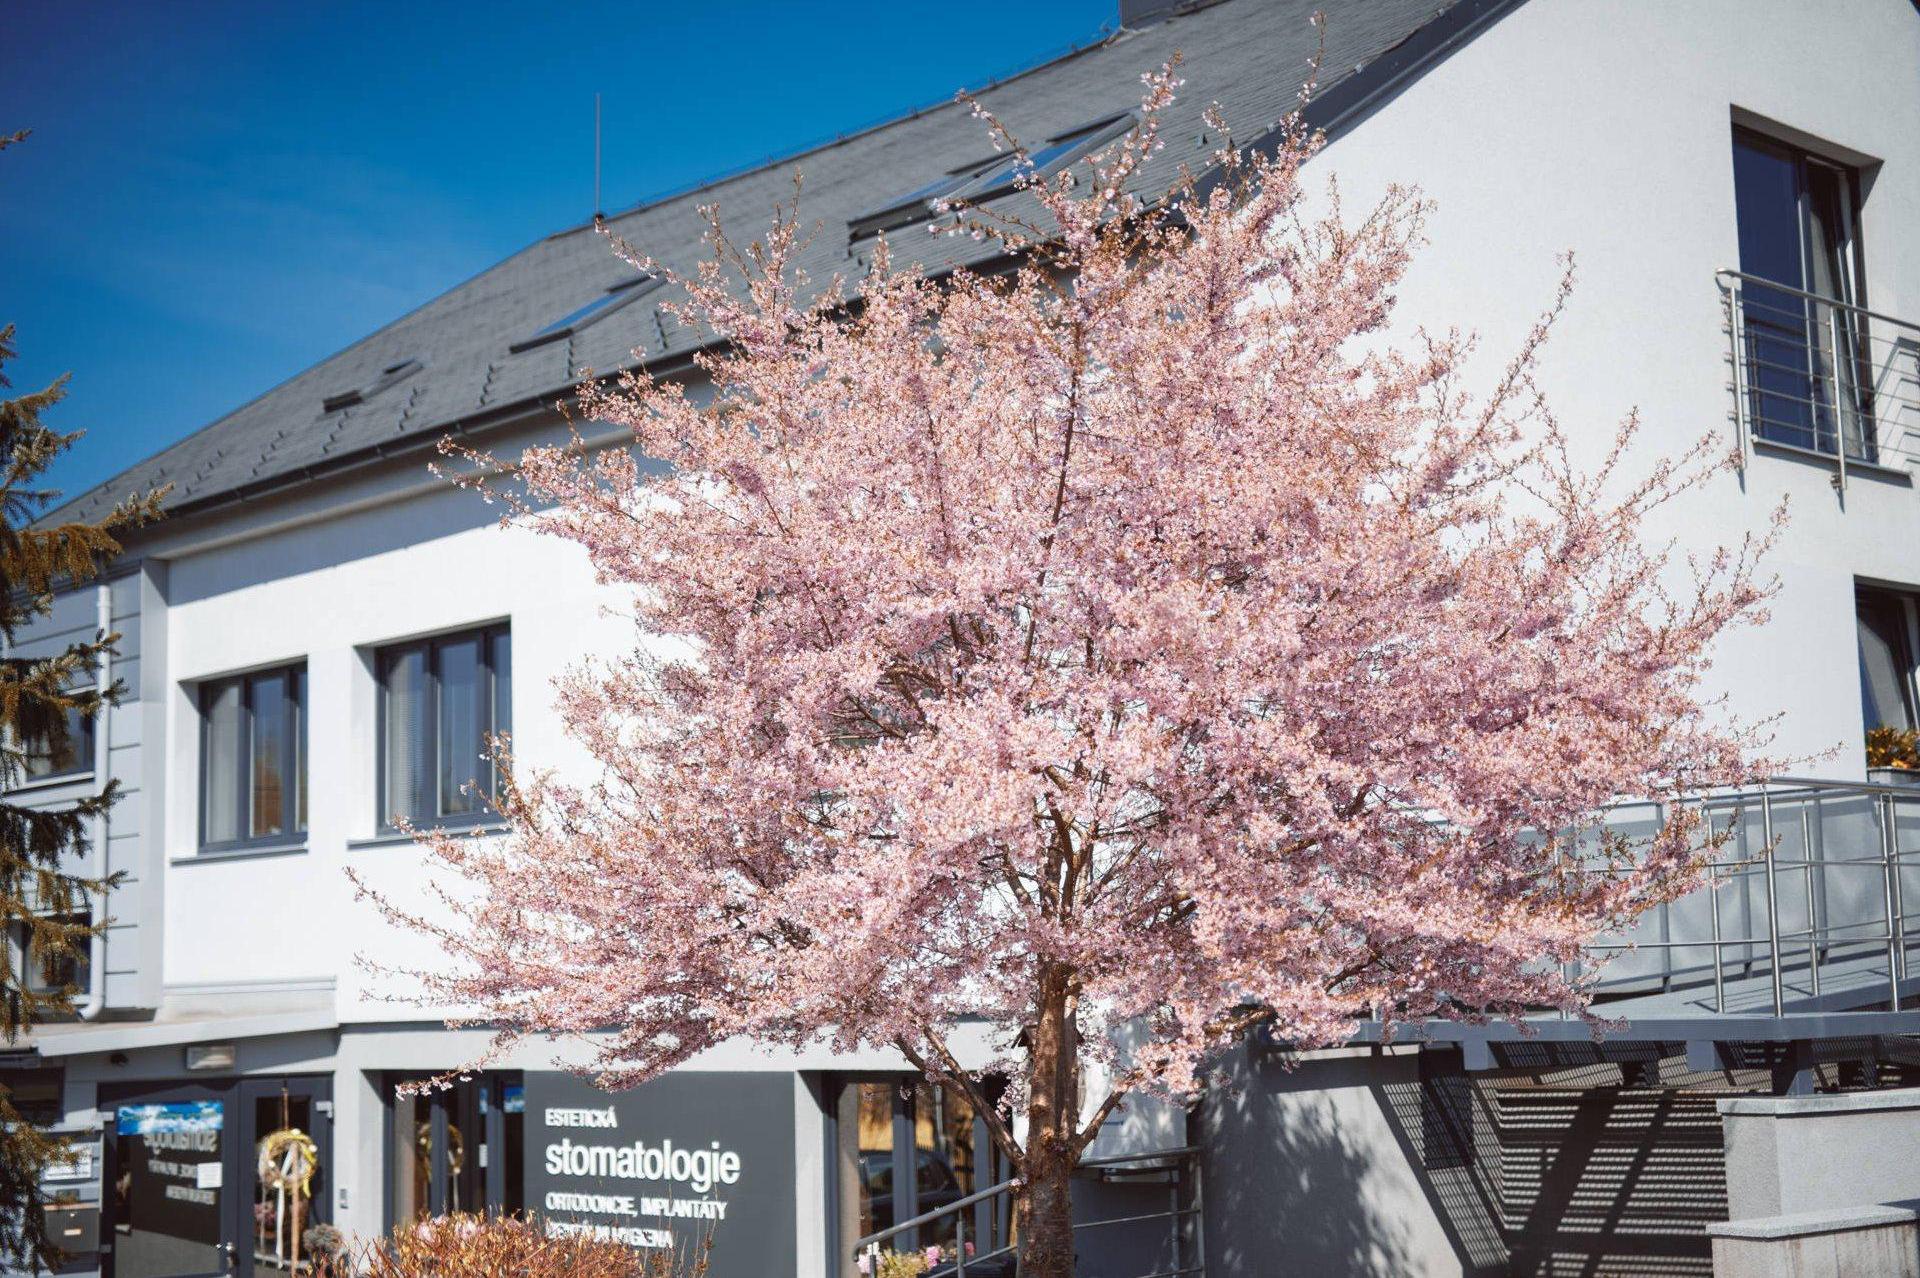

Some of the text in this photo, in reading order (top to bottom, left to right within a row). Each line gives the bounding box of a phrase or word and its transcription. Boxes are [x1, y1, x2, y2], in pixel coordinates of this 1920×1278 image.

[545, 1106, 618, 1128] ESTETICKÁ
[545, 1137, 741, 1193] stomatologie
[641, 1195, 728, 1220] IMPLANTÁTY
